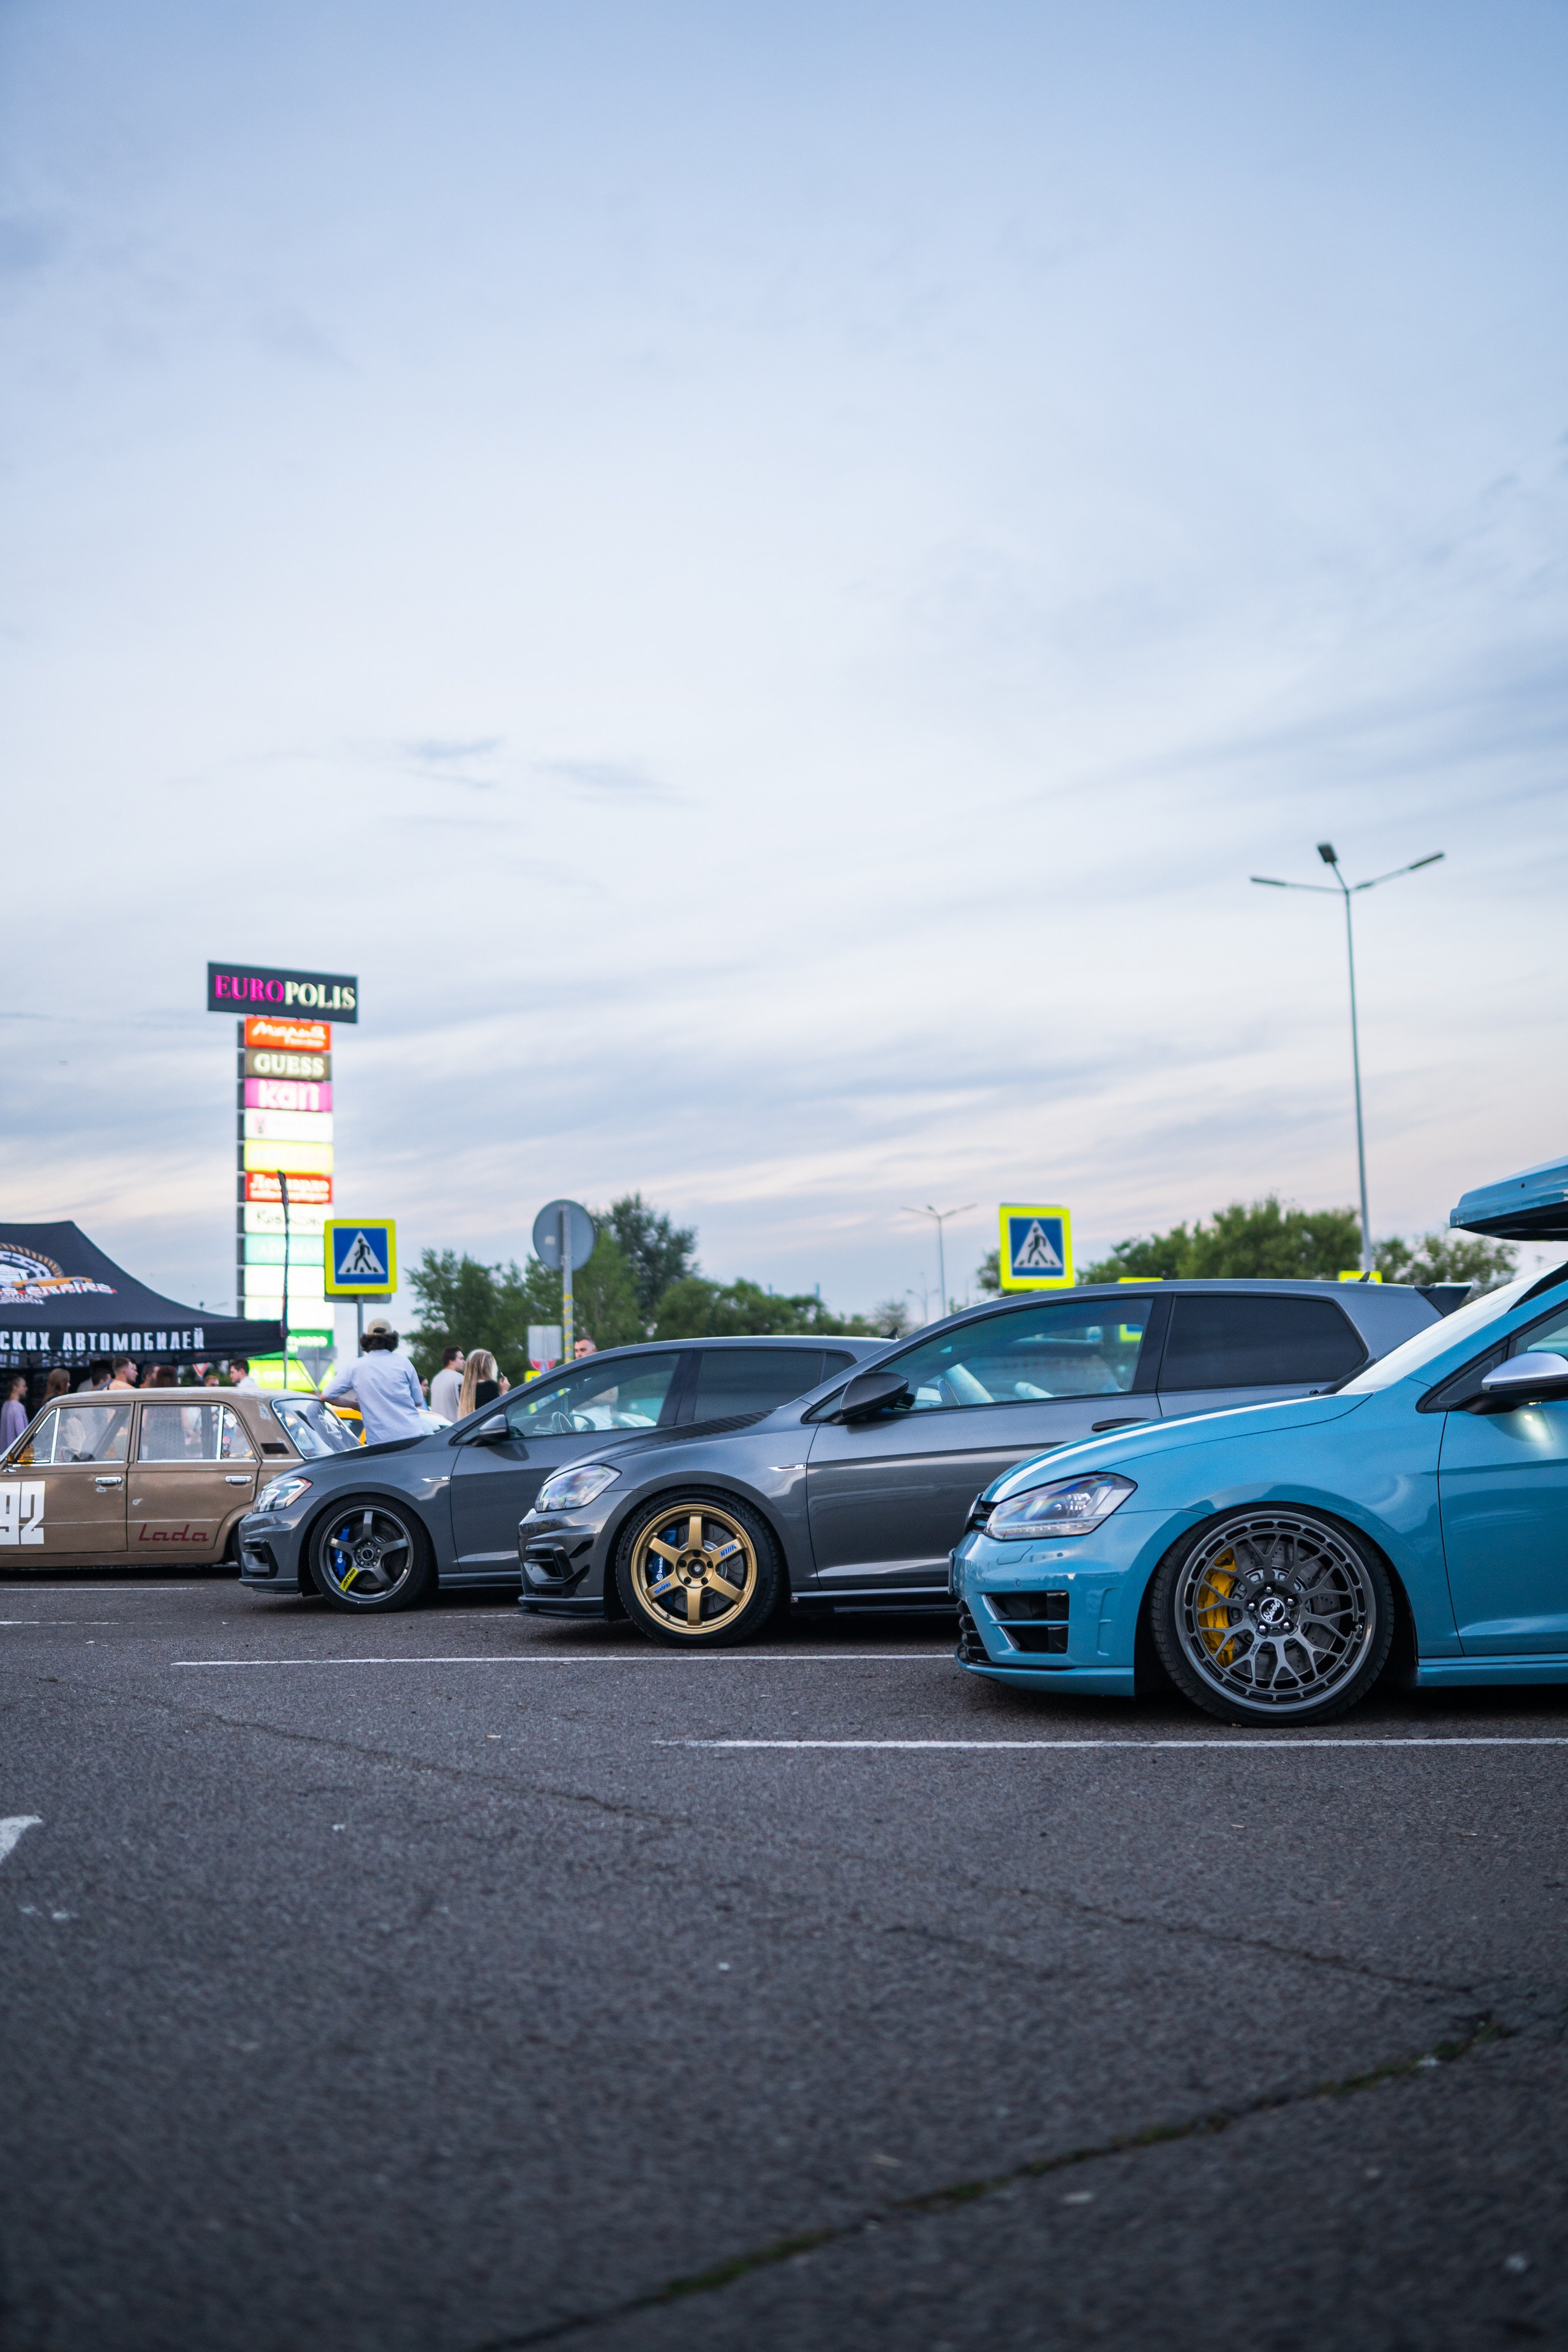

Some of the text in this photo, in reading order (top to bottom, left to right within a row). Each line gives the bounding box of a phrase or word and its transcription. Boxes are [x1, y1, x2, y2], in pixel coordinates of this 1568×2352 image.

[216, 975, 356, 1009] EUROPOLIS
[254, 1053, 324, 1077] GUESS
[62, 1327, 205, 1351] АВТОМОБИЛЕЙ
[138, 1524, 209, 1542] Lada
